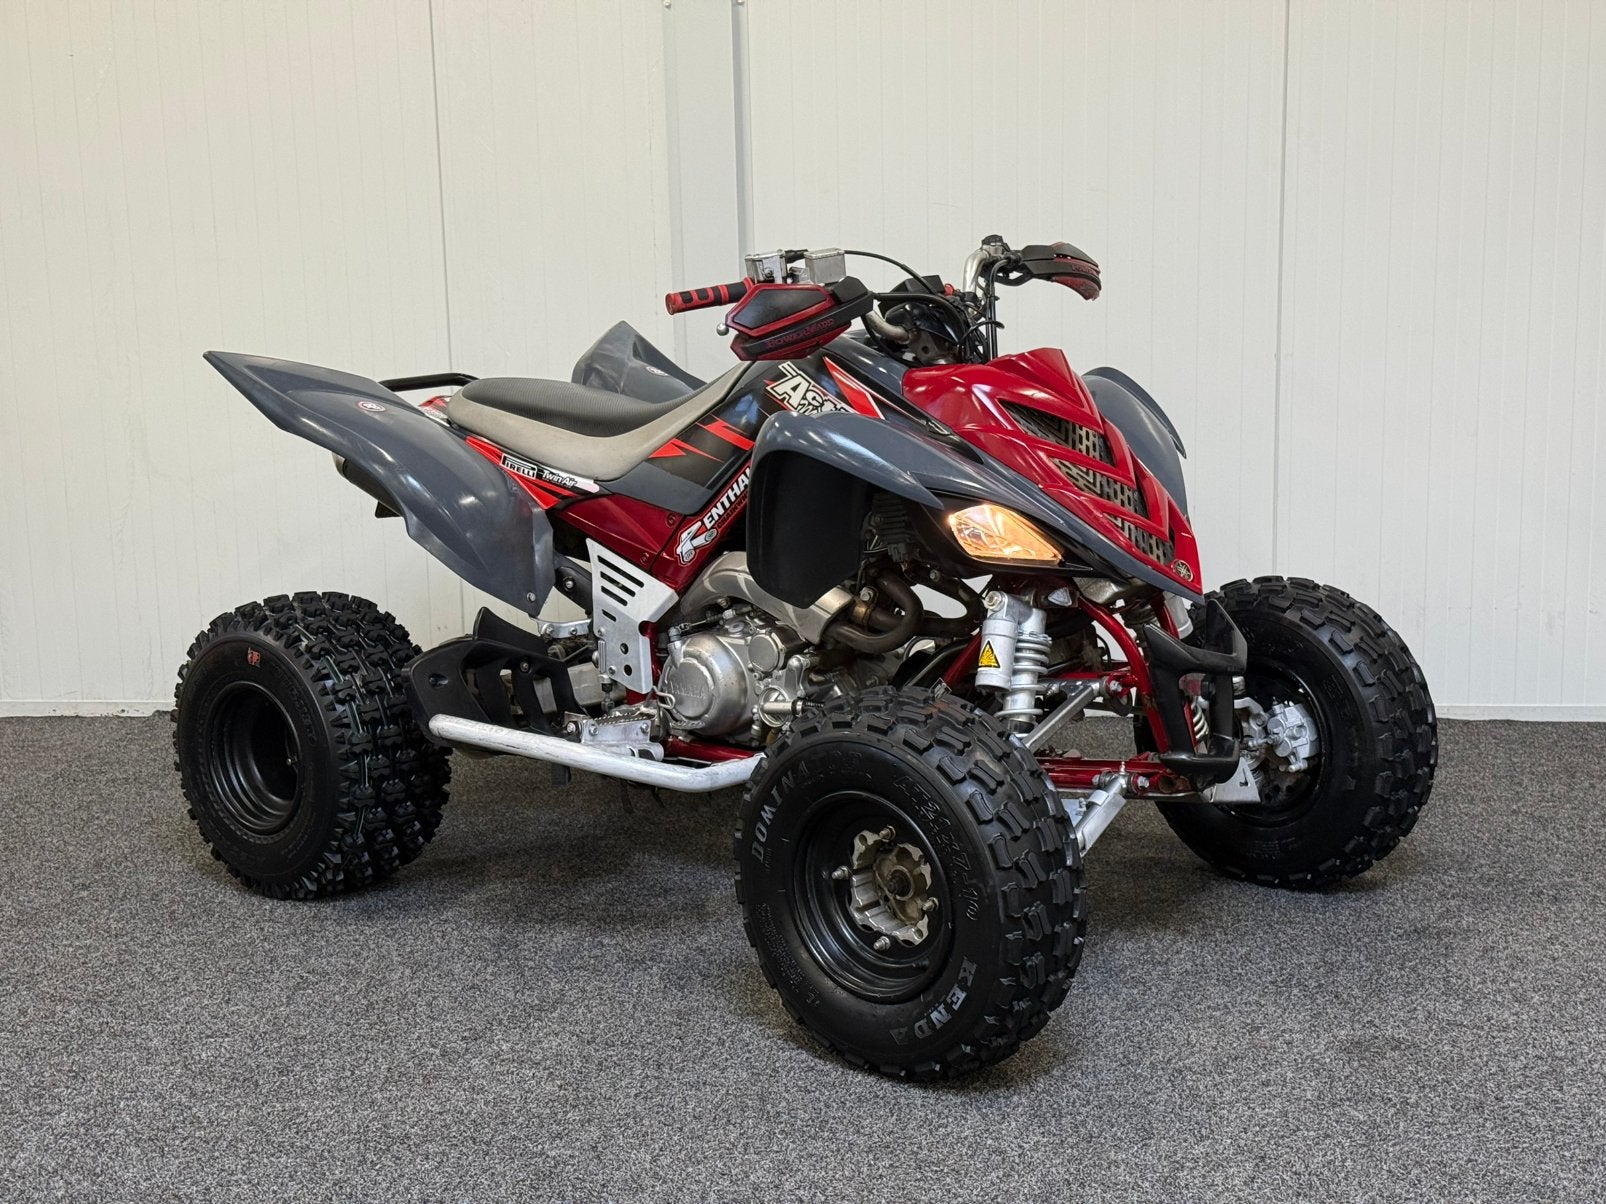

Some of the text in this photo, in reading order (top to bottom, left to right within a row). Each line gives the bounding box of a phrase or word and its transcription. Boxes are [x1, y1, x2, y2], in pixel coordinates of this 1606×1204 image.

[504, 456, 536, 479] PIRELLI
[542, 469, 563, 483] Twin
[562, 476, 578, 487] Air
[889, 955, 978, 1046] KENDA
